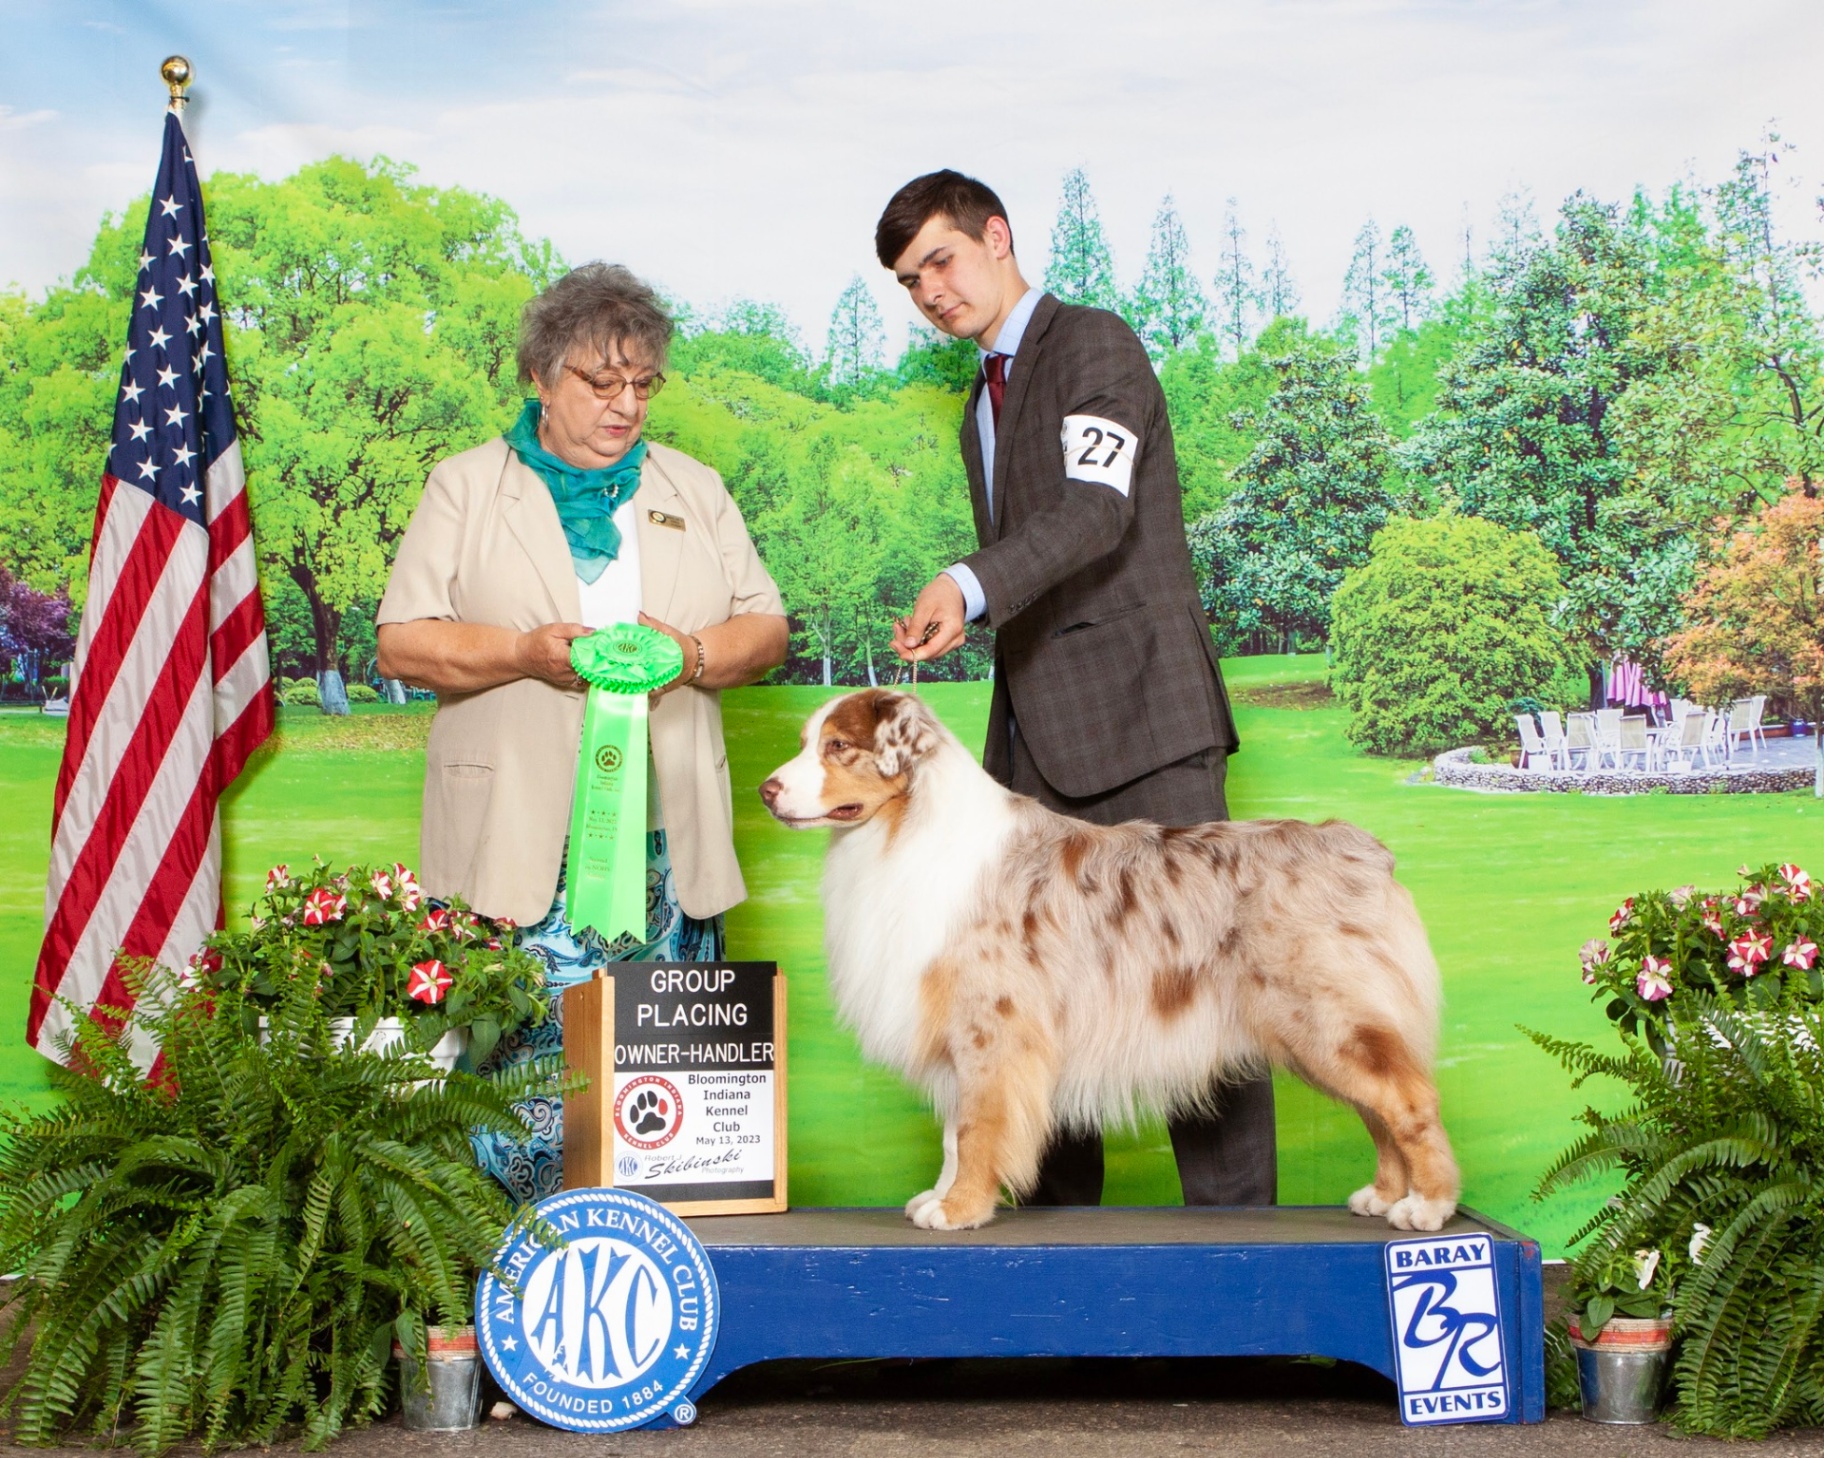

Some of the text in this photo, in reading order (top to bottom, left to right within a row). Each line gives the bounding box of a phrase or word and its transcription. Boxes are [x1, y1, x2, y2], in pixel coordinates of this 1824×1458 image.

[1077, 426, 1126, 469] 27
[650, 969, 736, 993] GROUP
[637, 1003, 748, 1027] PLACING
[614, 1042, 775, 1065] OWNER-HANDLER
[688, 1073, 767, 1086] Bloomington
[615, 1076, 661, 1117] BLOOMINGTON
[703, 1089, 751, 1101] Indiana
[705, 1105, 748, 1116] Kennel
[713, 1121, 741, 1132] Club
[696, 1135, 761, 1146] May 13, 2023
[645, 1148, 743, 1179] Skibinski
[701, 1165, 745, 1175] Photography
[1396, 1243, 1486, 1268] BARAY
[586, 1208, 679, 1265] KENNEL
[672, 1264, 699, 1332] CLUB
[530, 1244, 661, 1384] AKC
[522, 1371, 664, 1414] FOUNDED 1884
[1410, 1391, 1501, 1416] EVENTS
